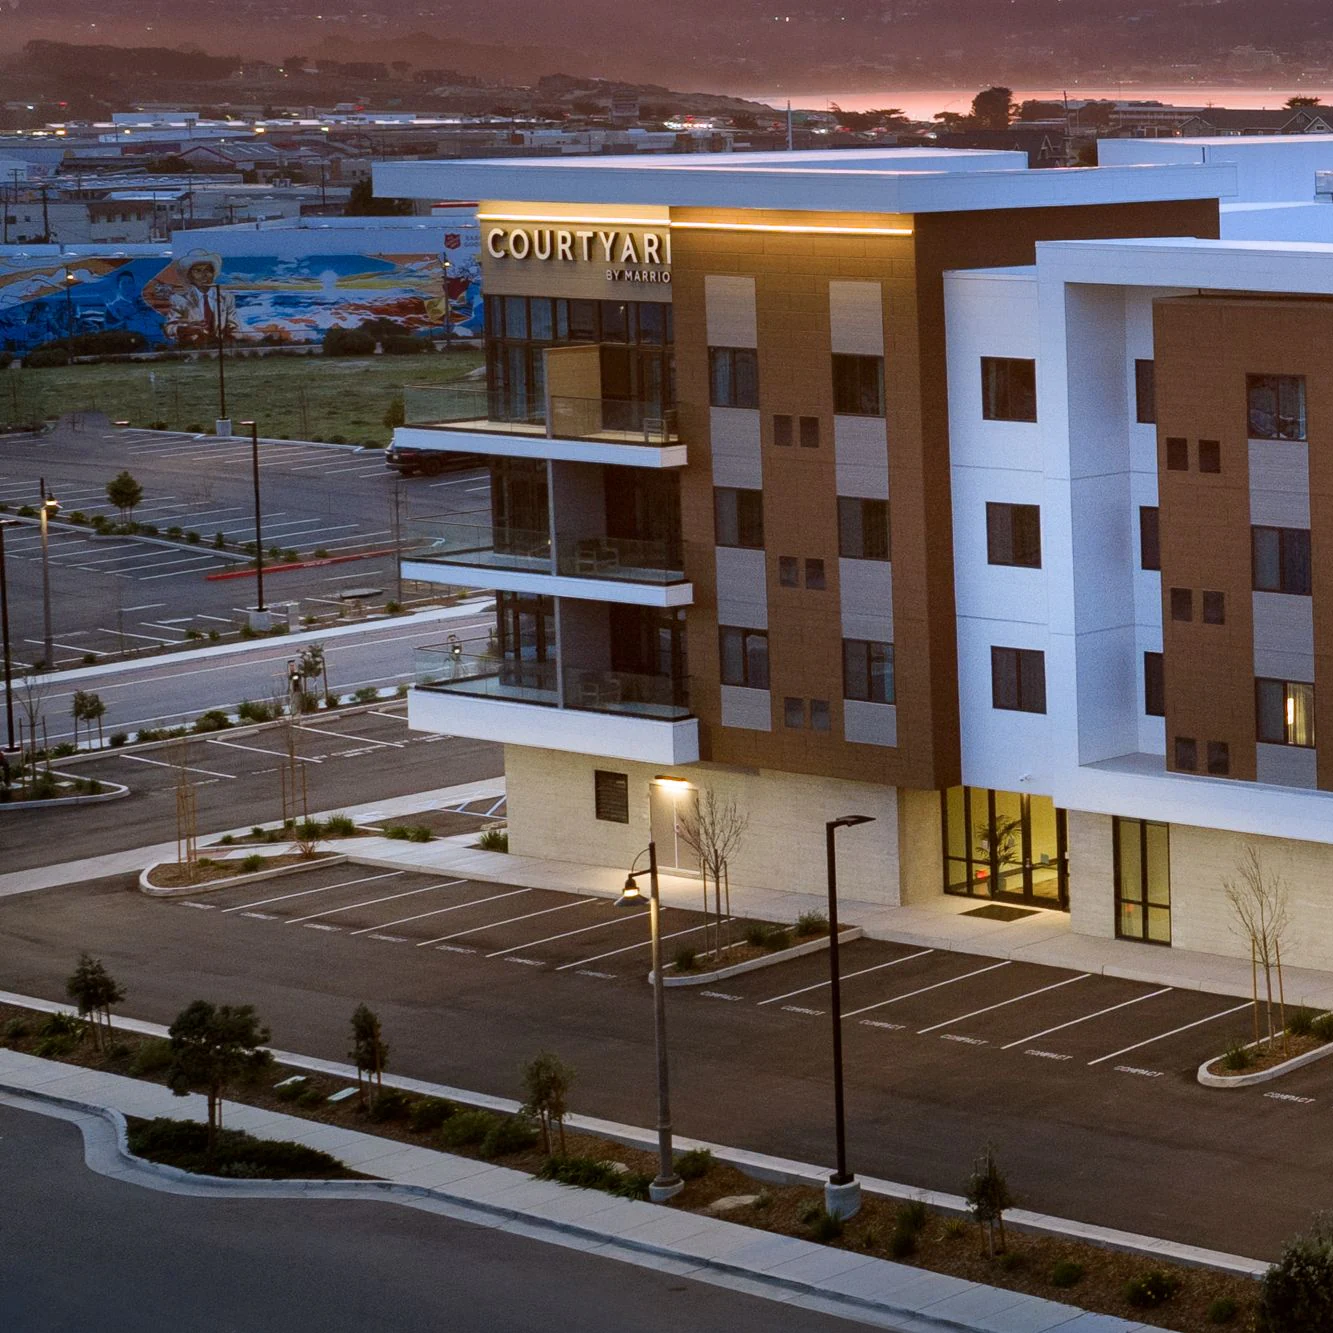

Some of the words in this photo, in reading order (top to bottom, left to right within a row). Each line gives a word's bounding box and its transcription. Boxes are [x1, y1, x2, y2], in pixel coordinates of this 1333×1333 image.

[606, 269, 620, 281] BY
[624, 270, 671, 283] MARRIO
[1263, 1091, 1316, 1104] COMPACT
